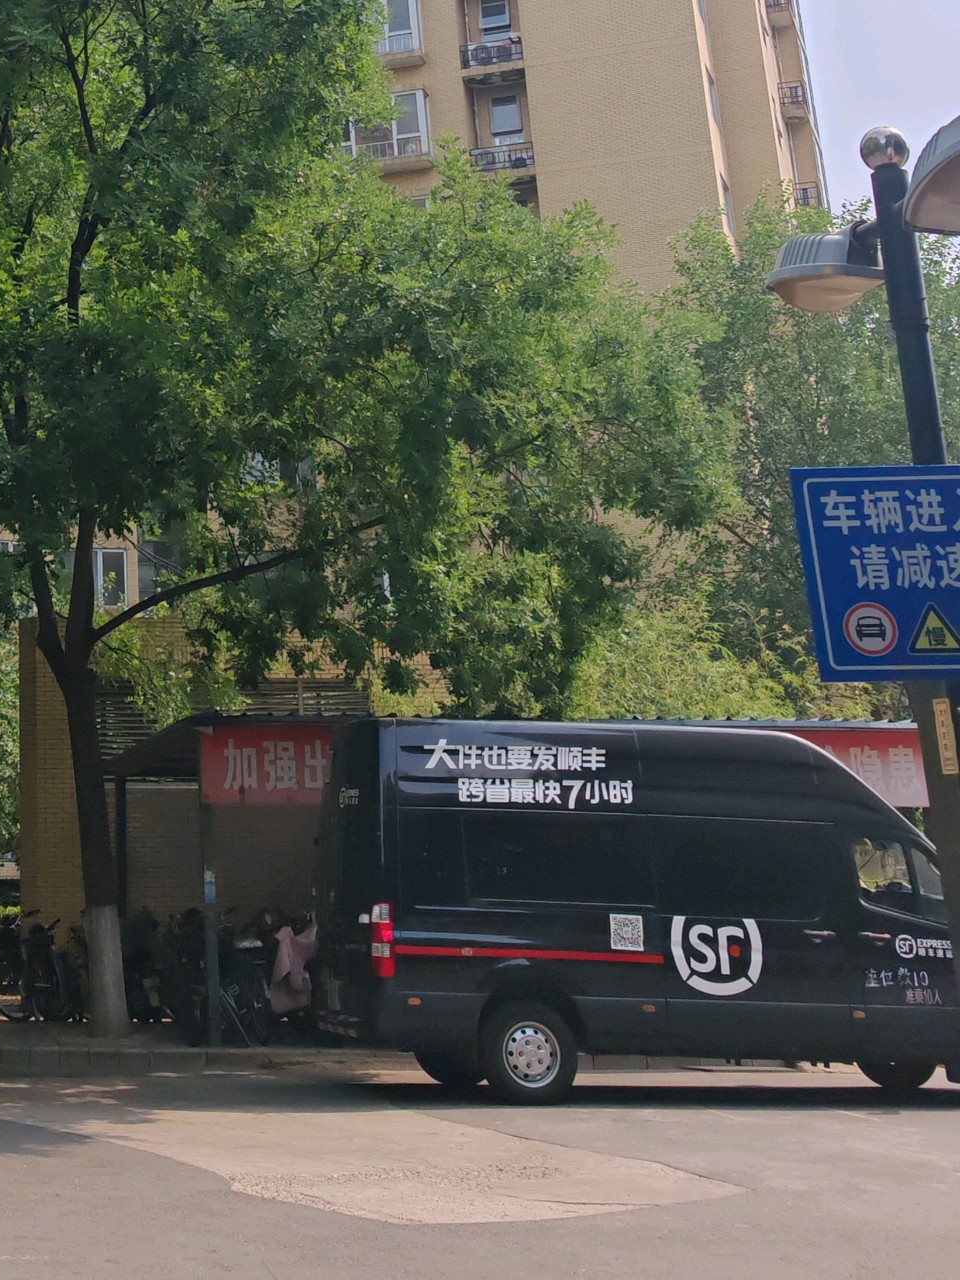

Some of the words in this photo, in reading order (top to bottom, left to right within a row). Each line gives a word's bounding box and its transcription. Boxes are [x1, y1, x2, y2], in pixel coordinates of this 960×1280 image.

[820, 489, 960, 535] 车辆进
[850, 543, 960, 590] 请减速
[925, 626, 948, 647] 慢
[423, 738, 607, 771] 大件也要发顺丰
[824, 745, 921, 794] 隐患
[458, 778, 634, 810] 跨省最快7小时
[916, 938, 952, 949] EXPRESS
